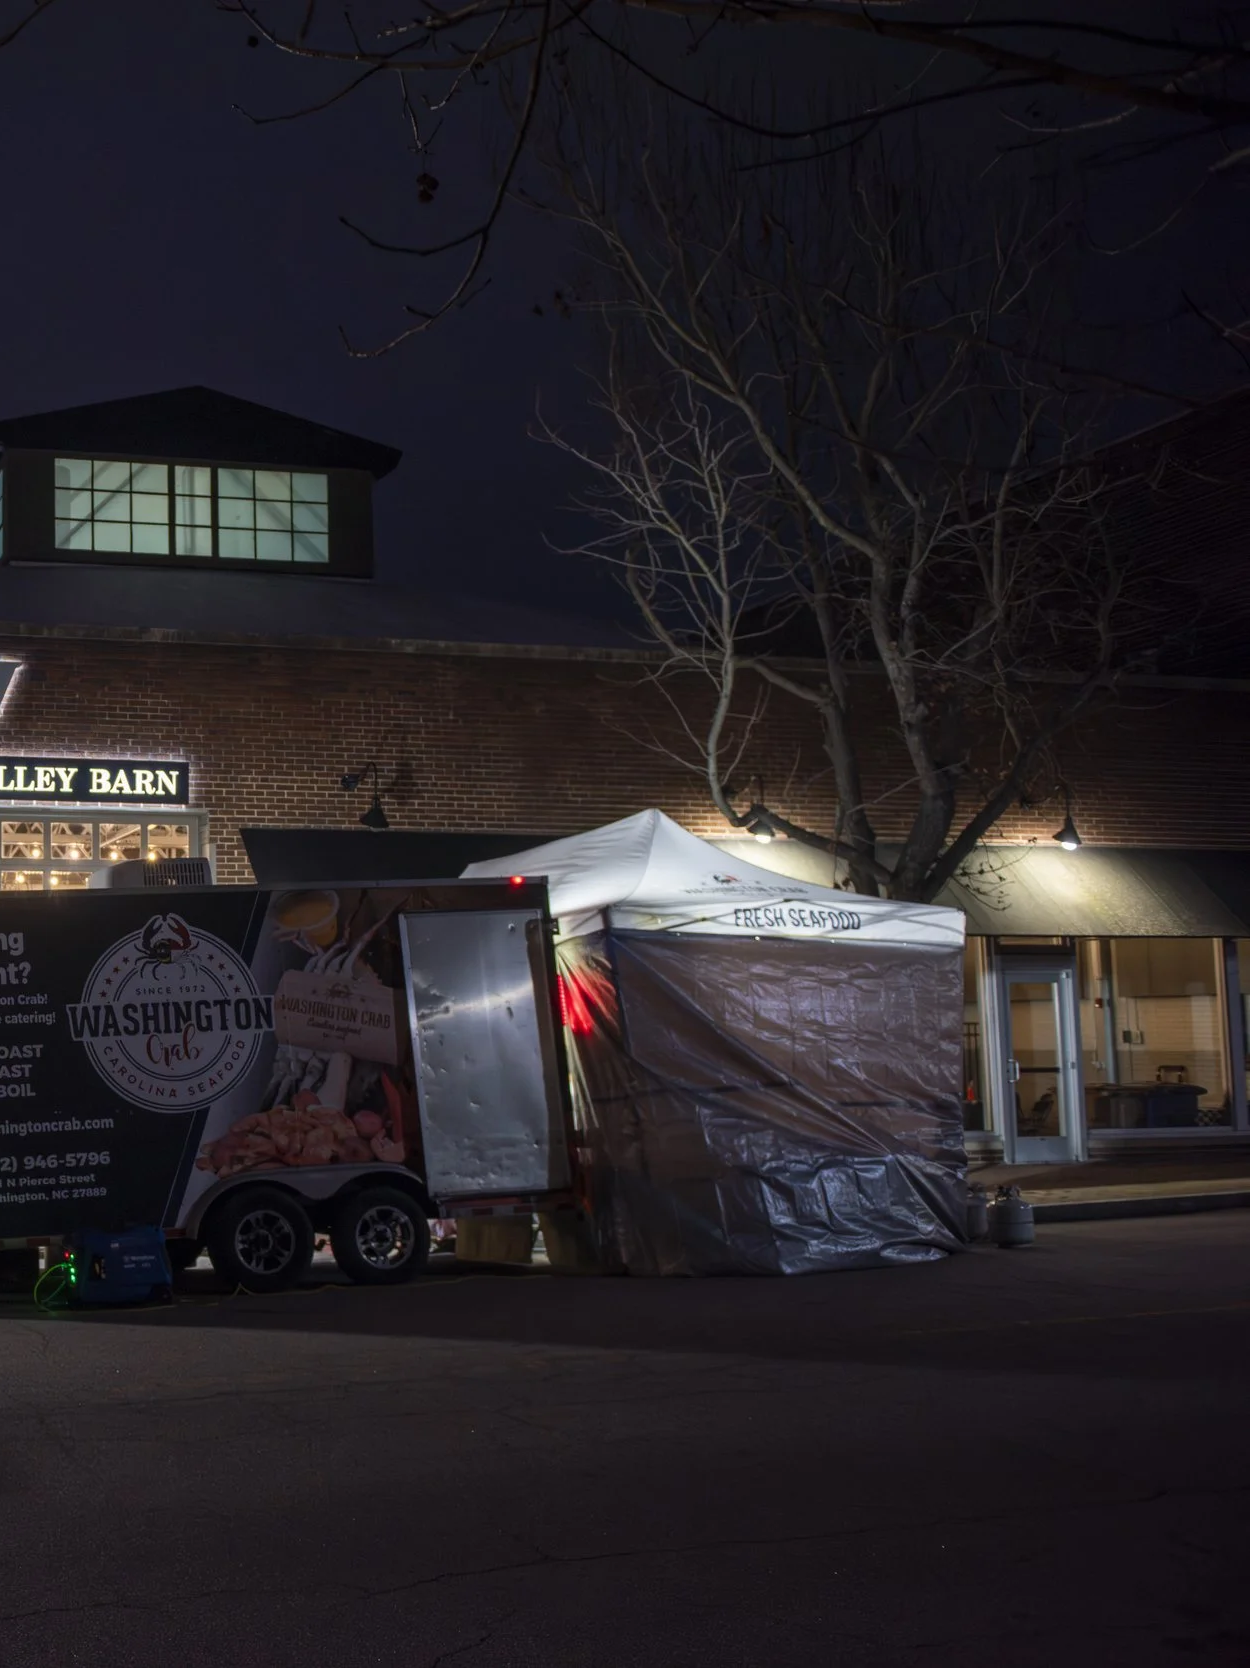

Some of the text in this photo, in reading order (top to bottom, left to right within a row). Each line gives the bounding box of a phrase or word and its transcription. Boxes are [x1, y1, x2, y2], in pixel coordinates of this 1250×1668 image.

[89, 768, 179, 795] BARN
[734, 908, 861, 930] FRESH SEAFOOD
[17, 993, 48, 1005] Crab!
[135, 986, 172, 995] SINCE
[5, 1011, 56, 1026] catering!
[68, 997, 274, 1038] WASHINGTON
[361, 1010, 391, 1029] CRAB
[146, 1023, 202, 1067] Crab
[104, 1040, 245, 1098] CAROLINA SEAFOOD
[23, 1151, 110, 1170] 946-5796
[6, 1178, 16, 1188] N
[19, 1175, 56, 1187] Pierce
[59, 1173, 96, 1185] Street
[52, 1189, 70, 1199] NC
[72, 1187, 107, 1198] 27889
